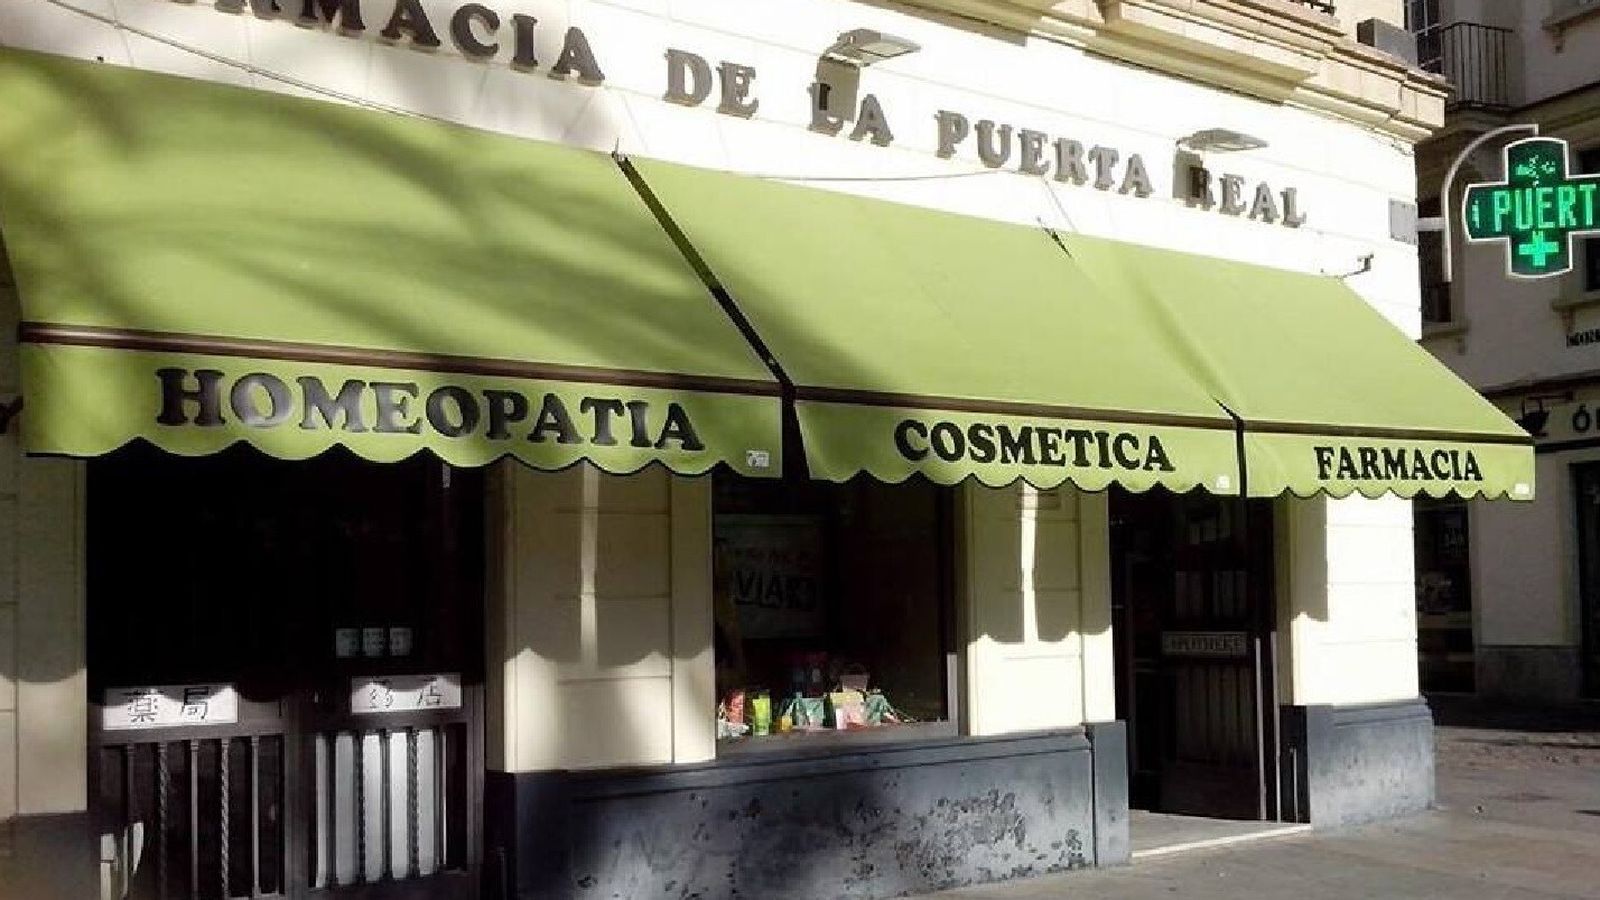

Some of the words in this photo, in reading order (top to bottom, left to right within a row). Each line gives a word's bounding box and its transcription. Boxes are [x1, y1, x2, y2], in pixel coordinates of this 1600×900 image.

[165, 0, 605, 86] MACIA
[662, 48, 759, 120] DE
[807, 83, 894, 147] LA
[934, 110, 1155, 198] PUERTA
[1185, 164, 1307, 229] REAL
[1494, 183, 1597, 233] PUERT
[154, 366, 706, 451] HOMEOPATIA
[893, 419, 1177, 472] COSMETICA
[1313, 446, 1484, 481] FARMACIA
